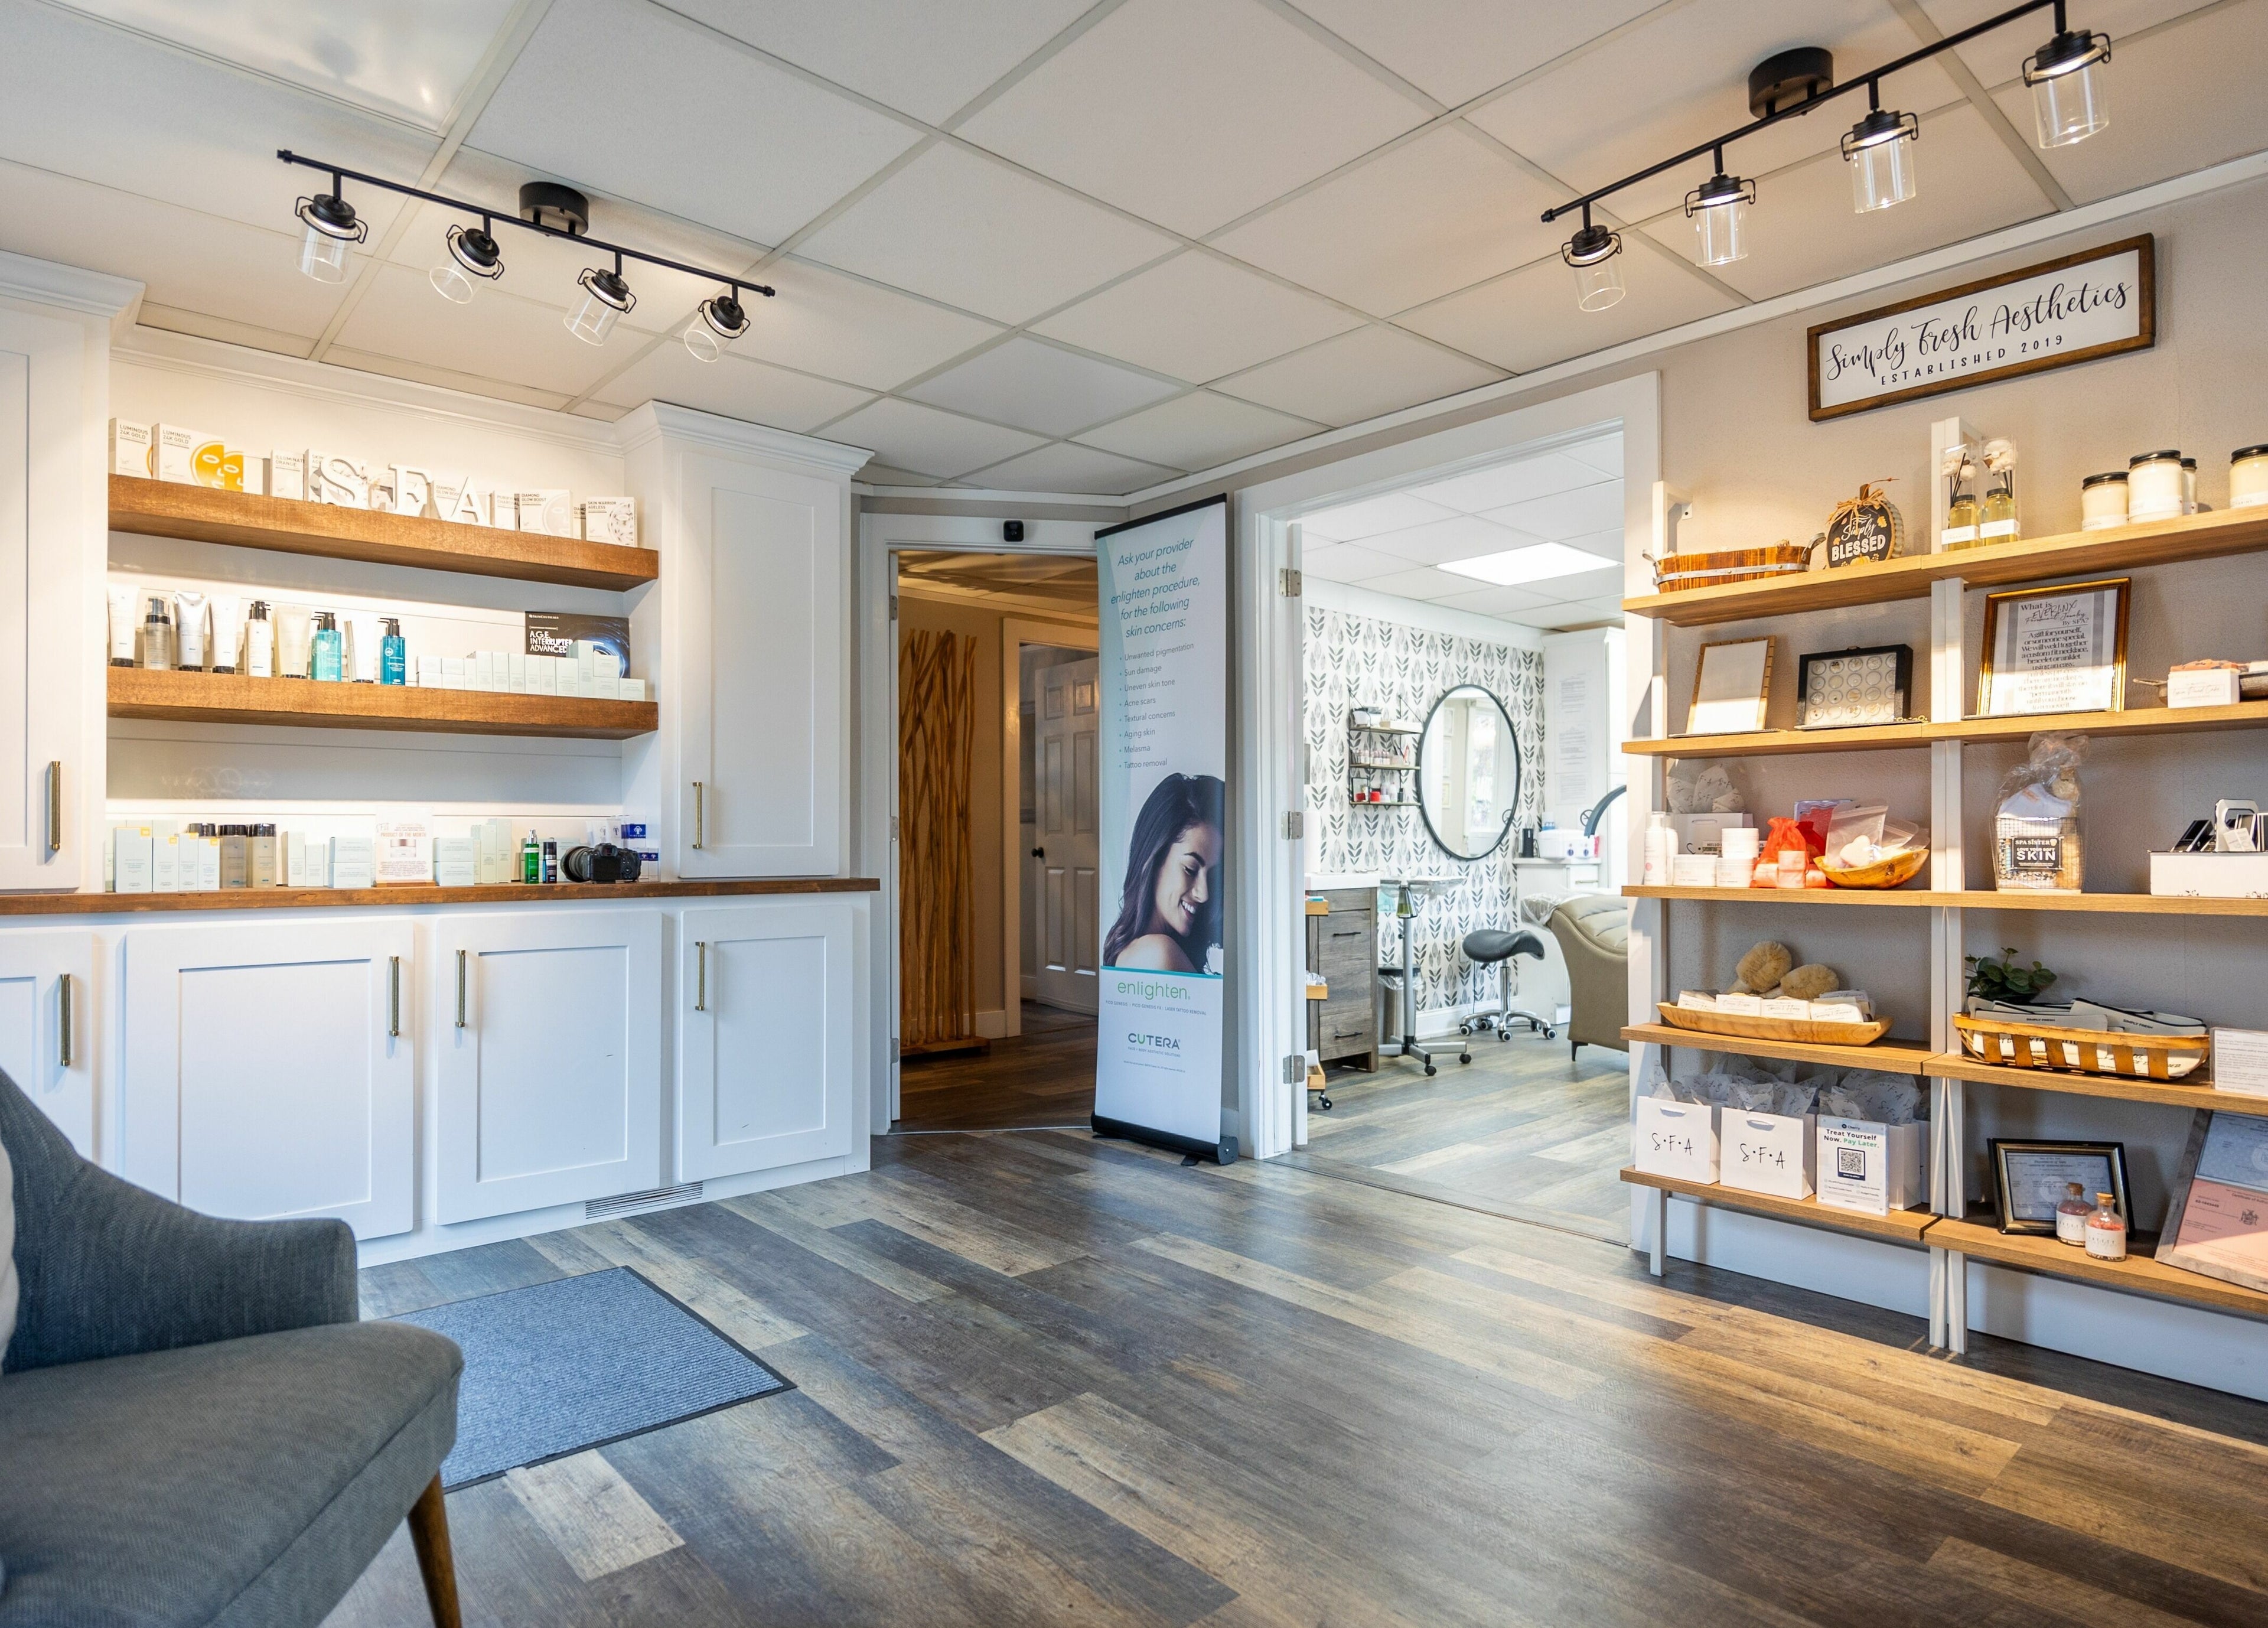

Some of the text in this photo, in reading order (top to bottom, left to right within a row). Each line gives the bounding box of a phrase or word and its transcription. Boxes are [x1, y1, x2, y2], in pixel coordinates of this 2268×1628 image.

[1826, 281, 2132, 380] Simply Fresh Aesthetics
[1881, 334, 2064, 386] ESTABLISHED 2019
[119, 424, 149, 435] LUMINOUS
[162, 429, 191, 440] LUMINOUS
[1117, 538, 1194, 566] Ask your provider
[1832, 535, 1886, 562] BLESSED
[1134, 562, 1177, 581] about the
[1110, 577, 1200, 604] enlighten procedure,
[1120, 598, 1190, 620] for the following
[2021, 602, 2043, 611] What
[1125, 618, 1187, 638] skin concerns:
[2060, 640, 2088, 649] together
[1124, 643, 1194, 661] Unwanted pigmentation
[1124, 665, 1162, 677] Sun damage
[1124, 679, 1175, 692] Uneven skin tone
[1124, 698, 1139, 707] Acne
[1124, 711, 1175, 722] Textural concerns
[1124, 728, 1155, 739] Aging skin
[1124, 744, 1151, 753] Melasma
[1124, 758, 1168, 769] Tattoo removal
[2016, 851, 2055, 861] SKIN
[1128, 1033, 1180, 1050] CUTERA
[1823, 1135, 1880, 1148] Now. Pay Later.
[1846, 1131, 1877, 1141] Yourself
